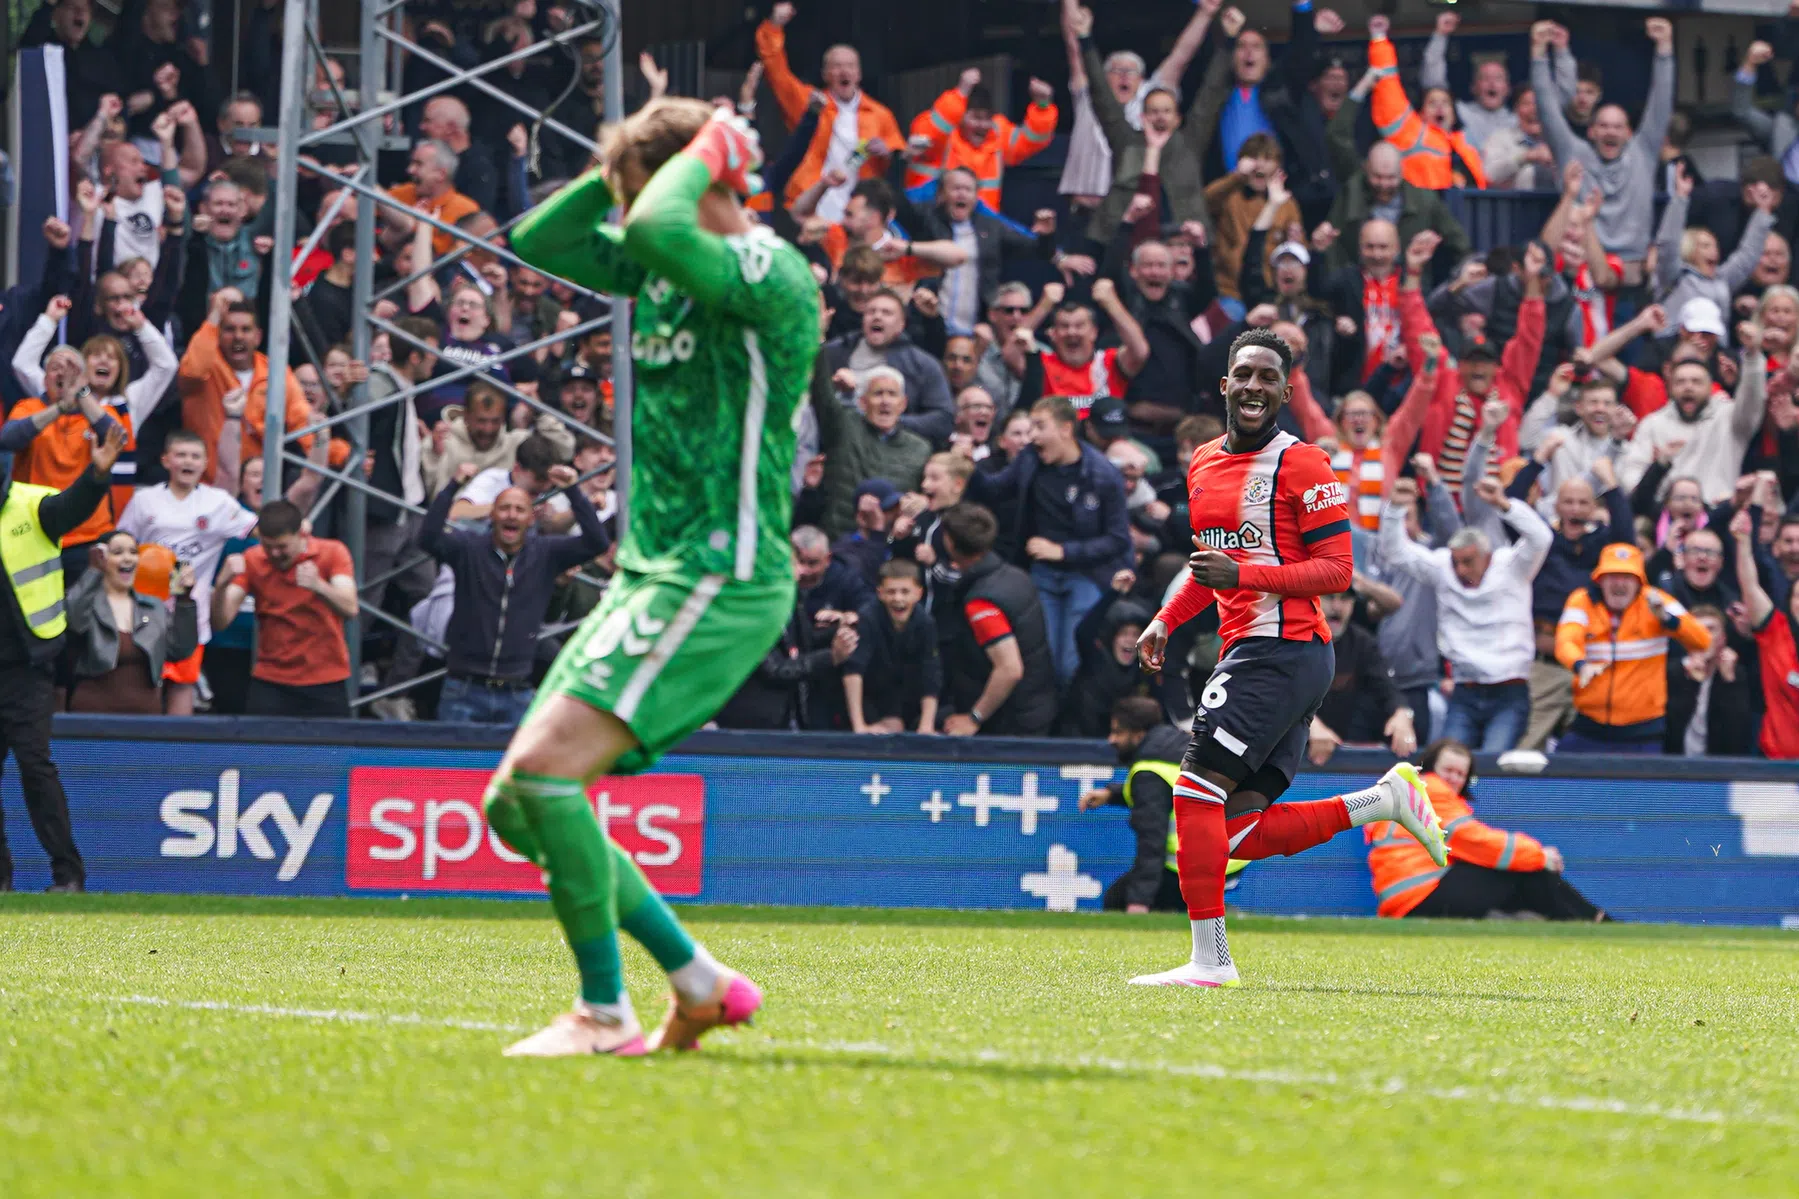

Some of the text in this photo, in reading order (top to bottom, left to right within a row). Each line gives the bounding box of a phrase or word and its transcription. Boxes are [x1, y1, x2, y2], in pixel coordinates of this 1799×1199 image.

[1321, 481, 1343, 498] STA
[1199, 527, 1240, 549] tilita
[1201, 672, 1232, 709] 6
[159, 768, 683, 882] sky spts
